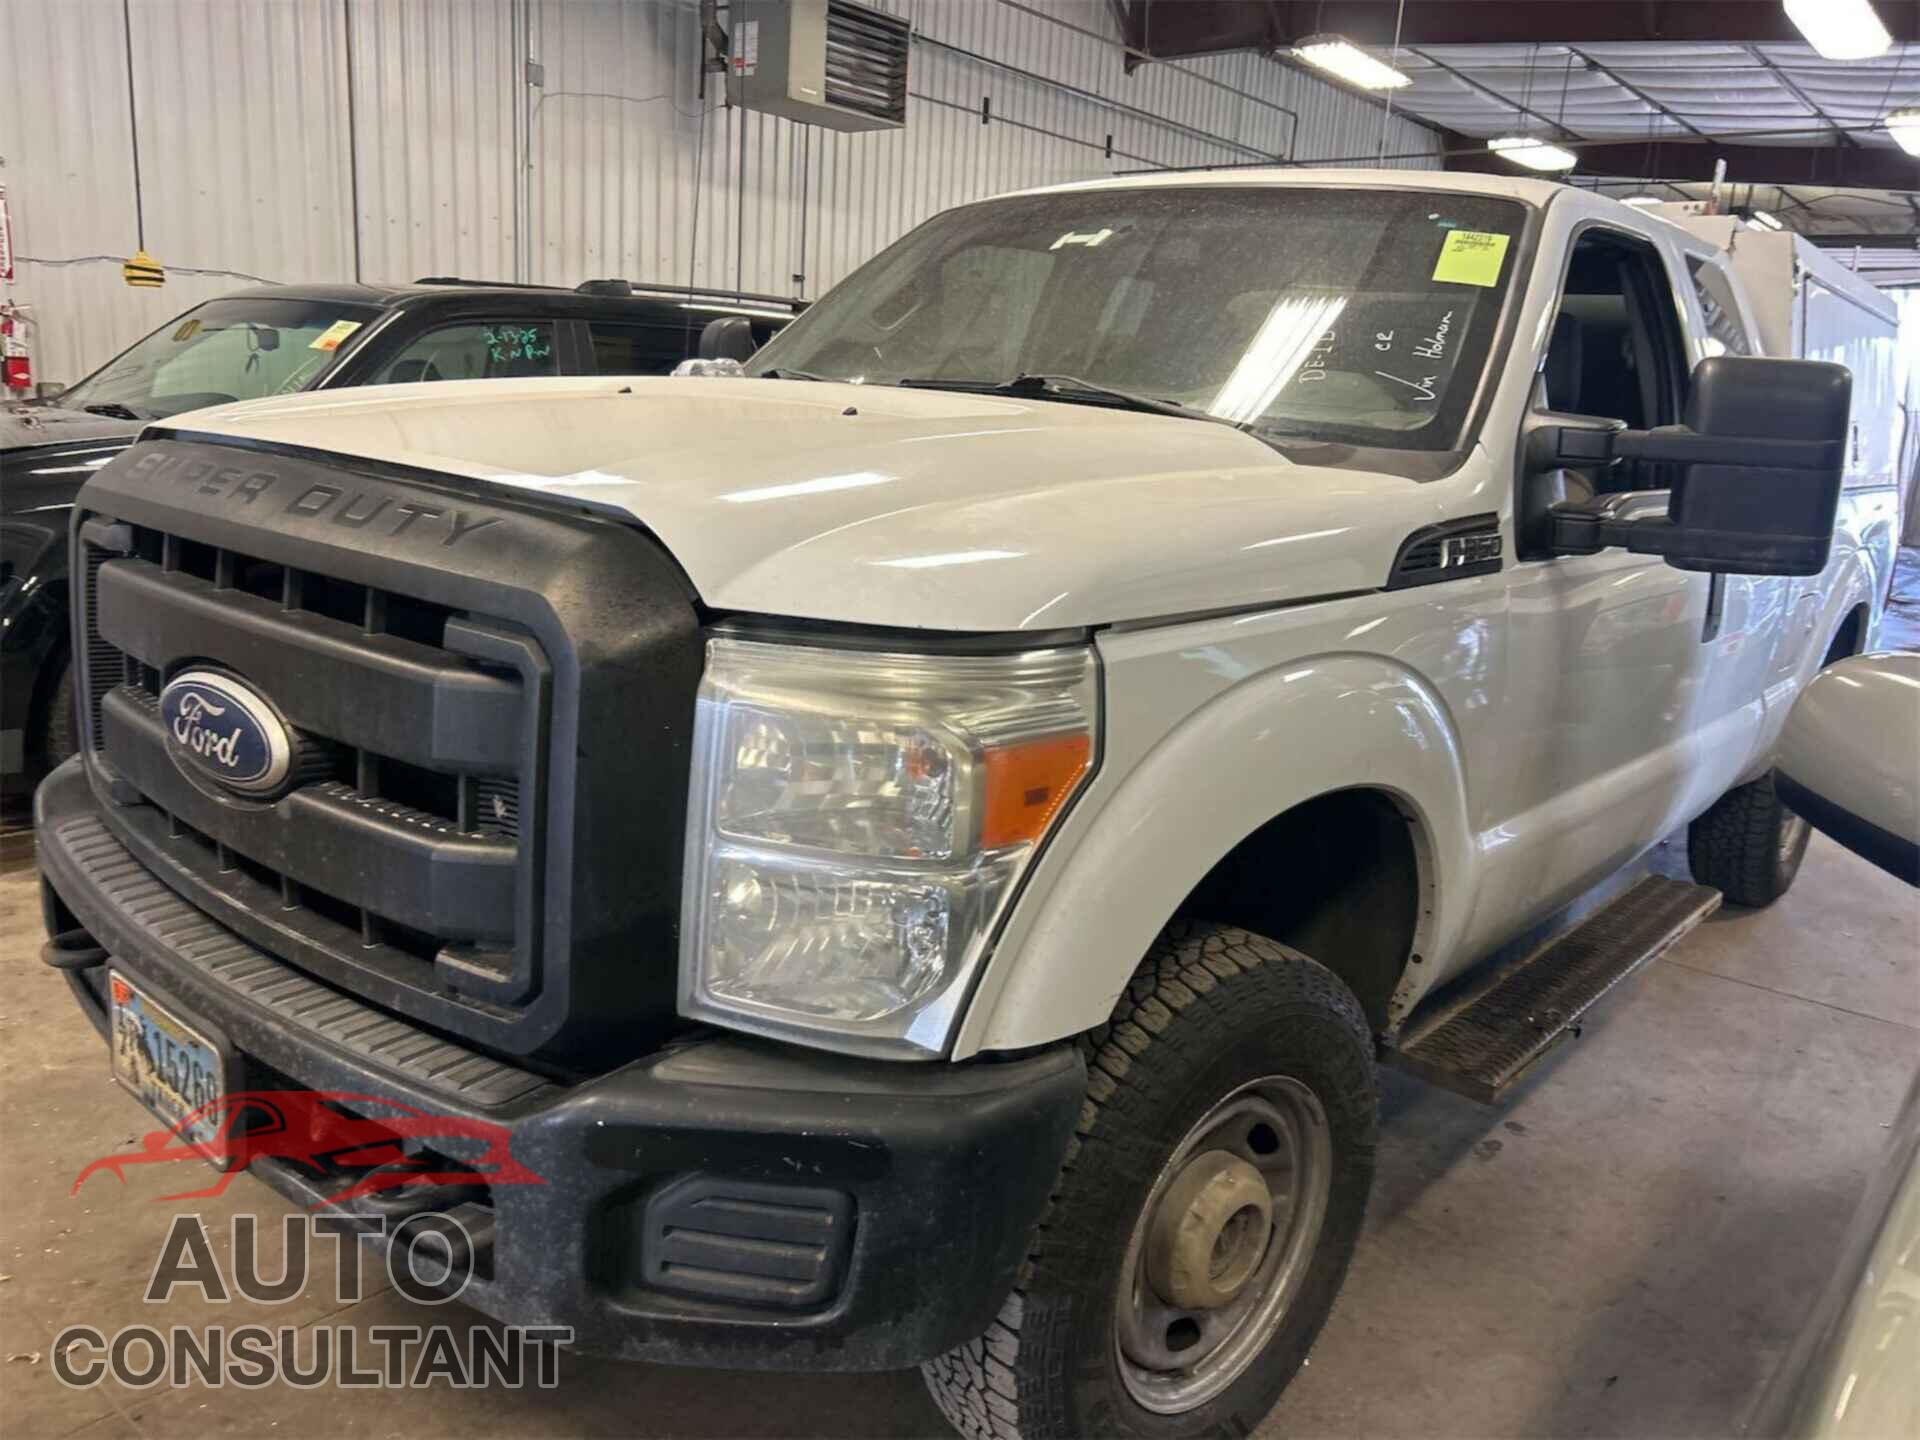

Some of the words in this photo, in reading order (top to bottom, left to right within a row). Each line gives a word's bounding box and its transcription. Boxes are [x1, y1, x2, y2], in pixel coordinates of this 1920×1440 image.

[125, 452, 279, 505] SUPER
[286, 481, 504, 548] DUTY
[173, 691, 243, 768] Ford
